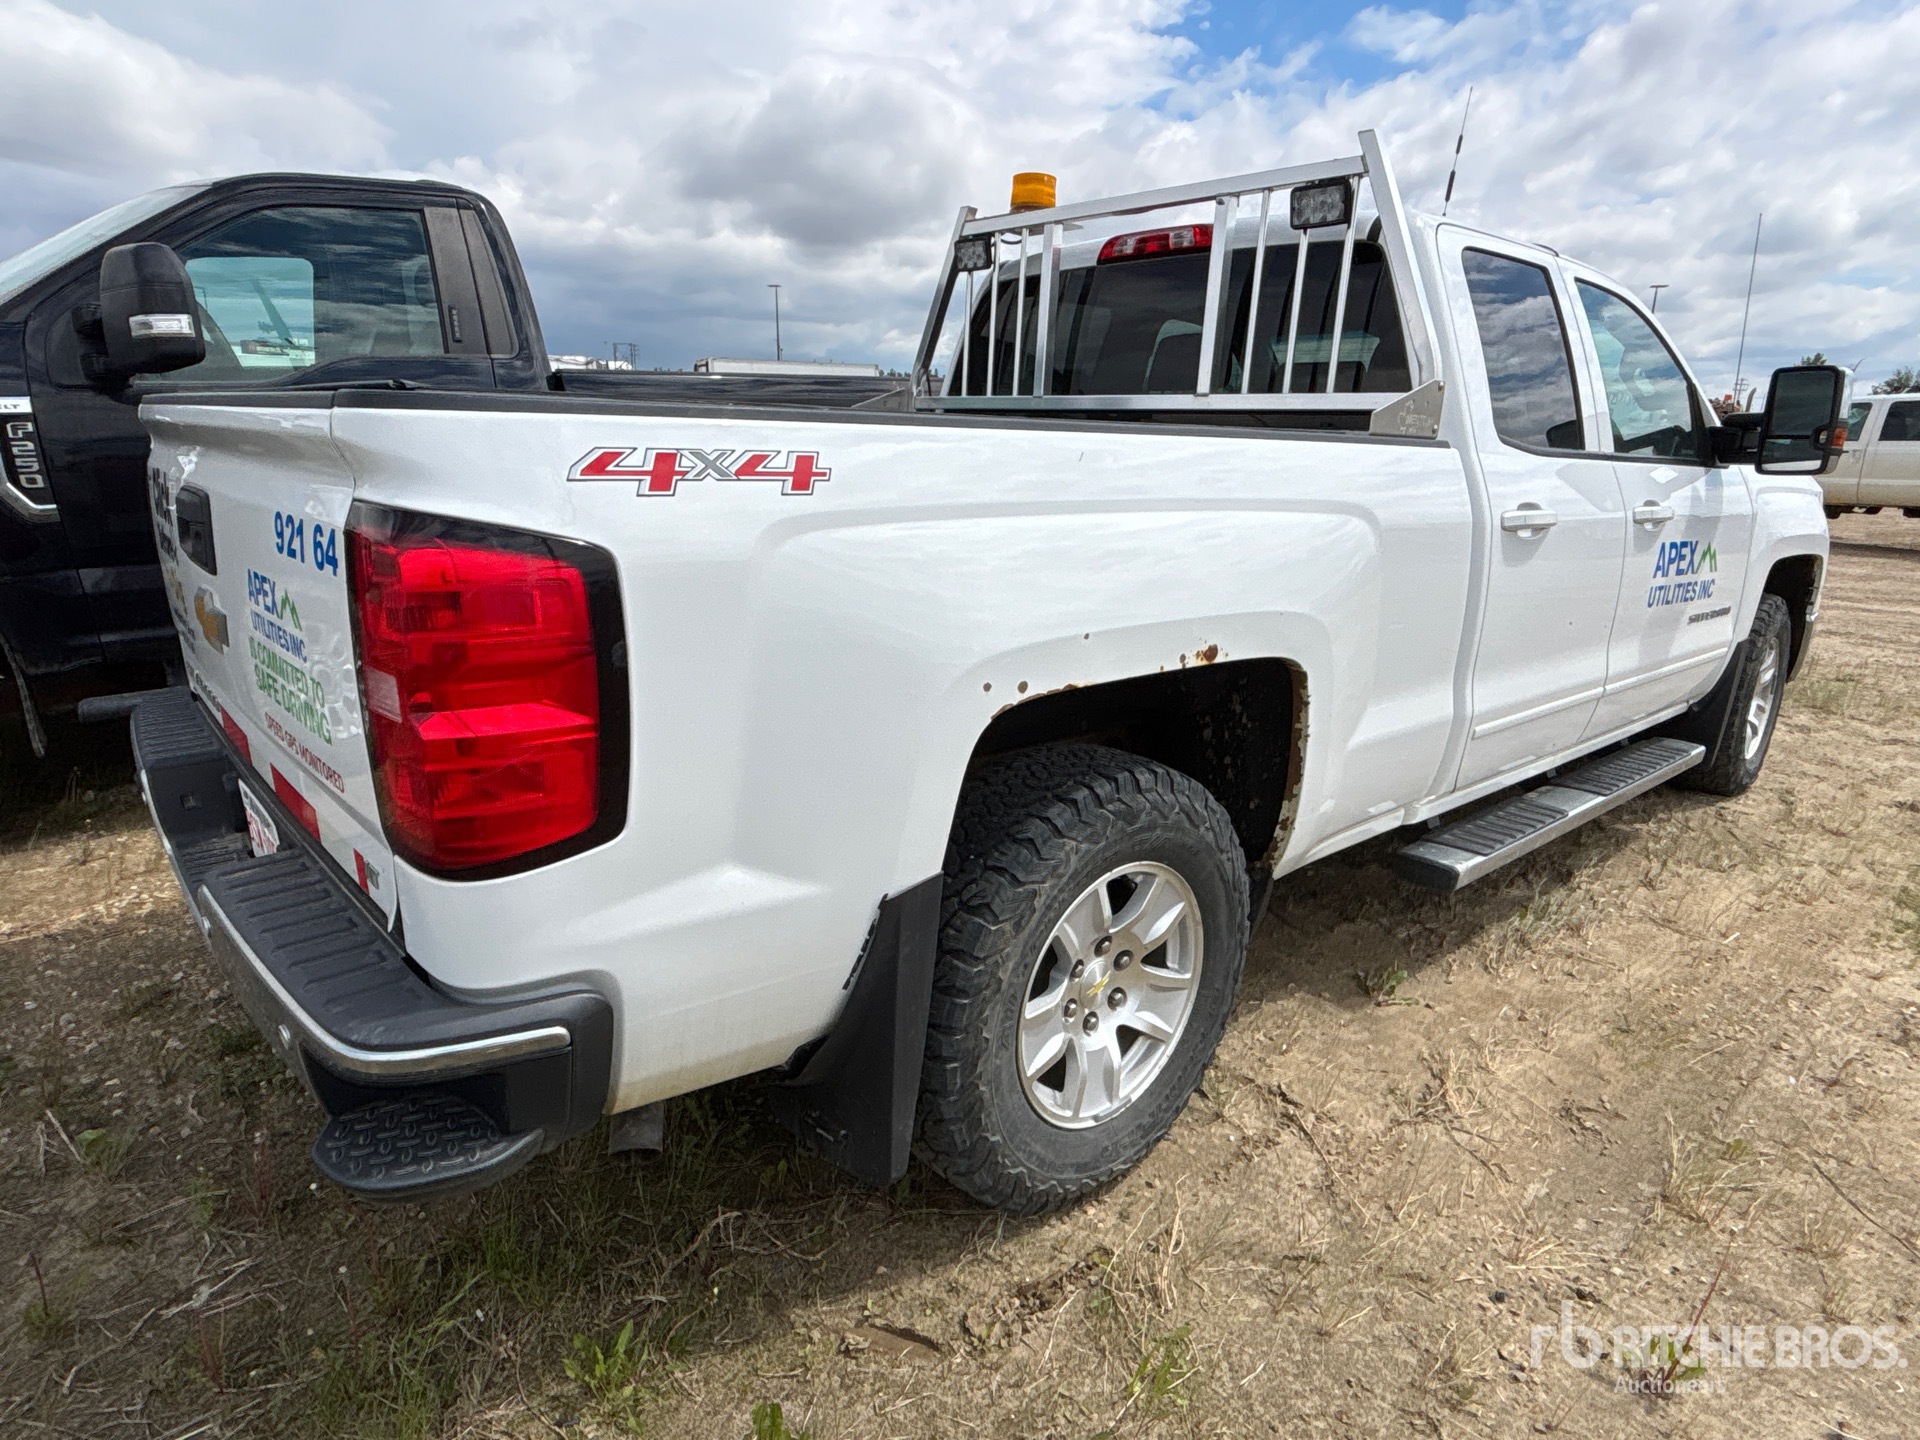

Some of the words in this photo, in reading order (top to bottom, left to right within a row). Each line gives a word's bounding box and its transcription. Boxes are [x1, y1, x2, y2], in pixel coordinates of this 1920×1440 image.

[6, 421, 45, 489] F250
[274, 511, 305, 564] 921
[313, 523, 338, 577] 64
[1653, 540, 1699, 579] APEX
[247, 568, 281, 619] APEX
[1647, 580, 1698, 608] UTILITIES
[1696, 578, 1715, 601] INC
[250, 609, 289, 653] UTILITIES
[288, 631, 307, 664] INC
[254, 663, 281, 706] SAFE
[280, 683, 332, 747] DRIVING
[257, 641, 308, 697] COMMITTED
[309, 676, 325, 709] TO
[264, 711, 285, 742] SPEED
[284, 730, 299, 755] GPS
[299, 743, 345, 793] MONITORED
